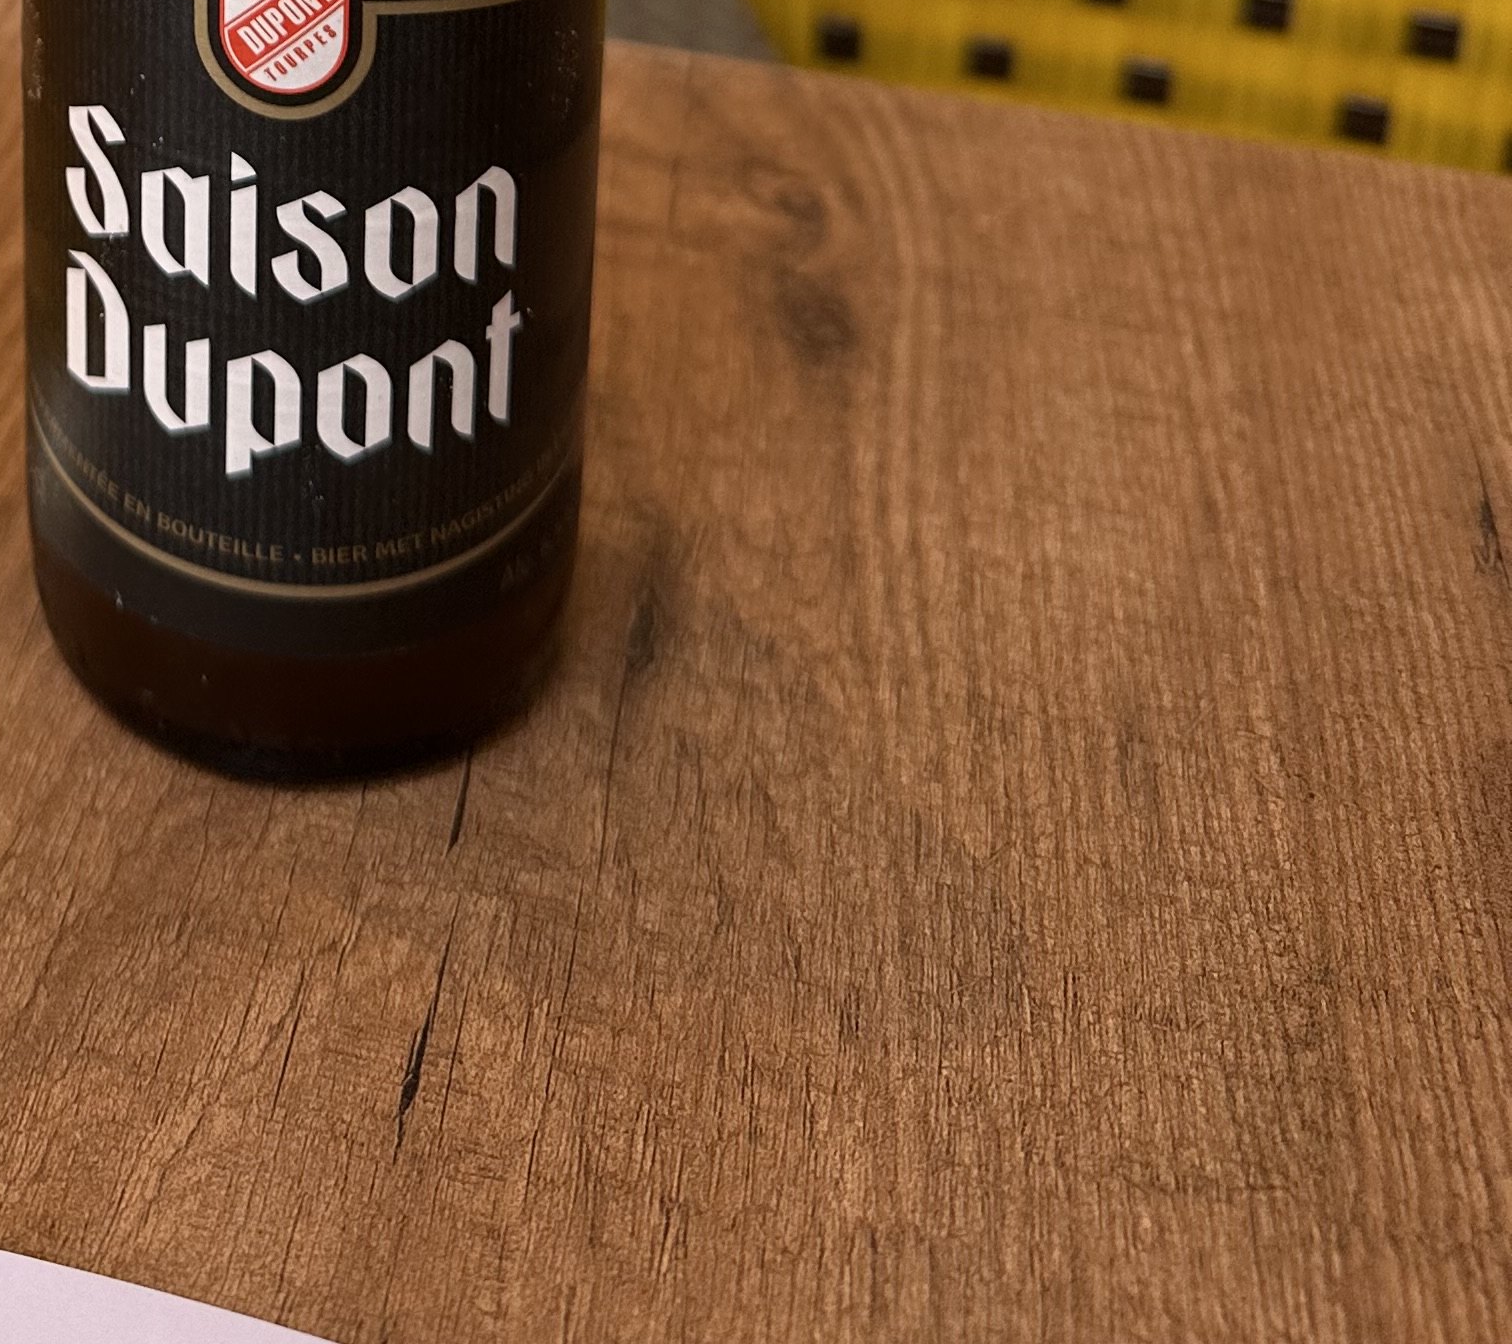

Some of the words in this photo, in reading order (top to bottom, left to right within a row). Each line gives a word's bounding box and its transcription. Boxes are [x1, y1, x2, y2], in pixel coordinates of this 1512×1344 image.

[264, 23, 338, 82] TOURPES
[65, 104, 518, 305] Saison
[66, 249, 522, 479] Dupont
[123, 492, 150, 522] EN
[156, 512, 285, 562] BOUTEILLE
[311, 543, 368, 564] BIER
[375, 531, 425, 560] MET
